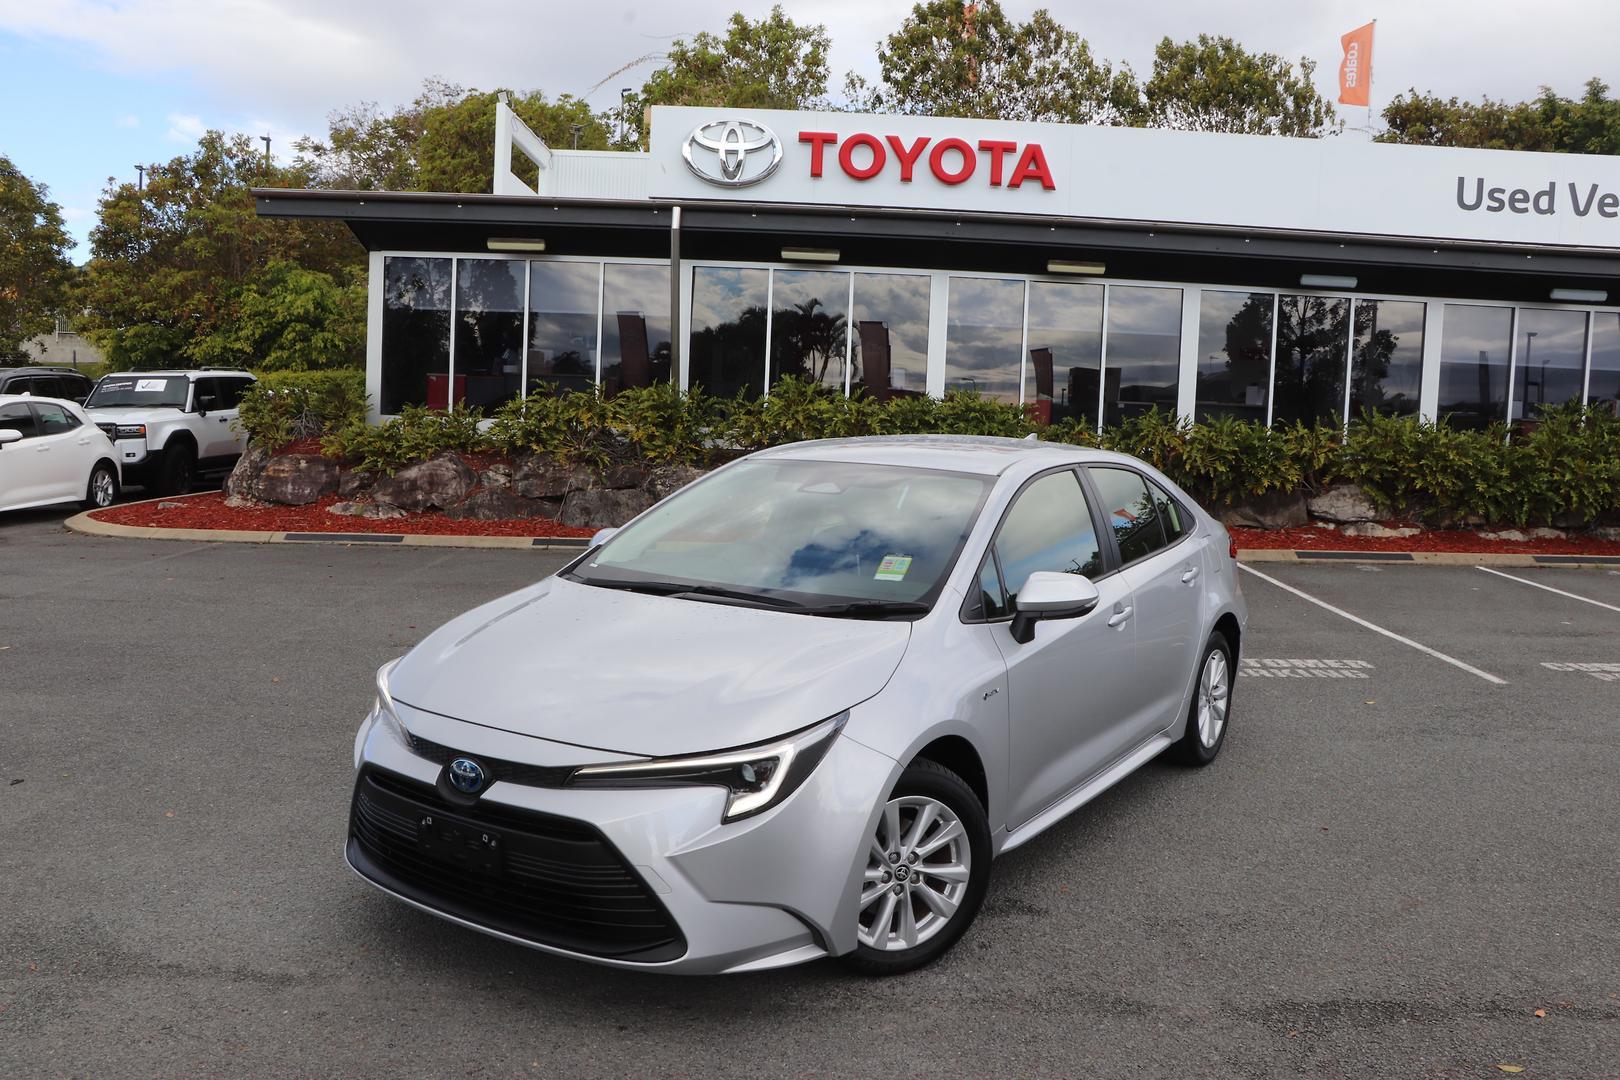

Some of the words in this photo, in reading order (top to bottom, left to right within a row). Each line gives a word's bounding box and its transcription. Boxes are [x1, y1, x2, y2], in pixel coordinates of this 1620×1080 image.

[798, 131, 1056, 190] TOYOTA
[1457, 176, 1556, 216] Used
[1568, 182, 1620, 218] Ve
[1241, 658, 1376, 669] TOMER
